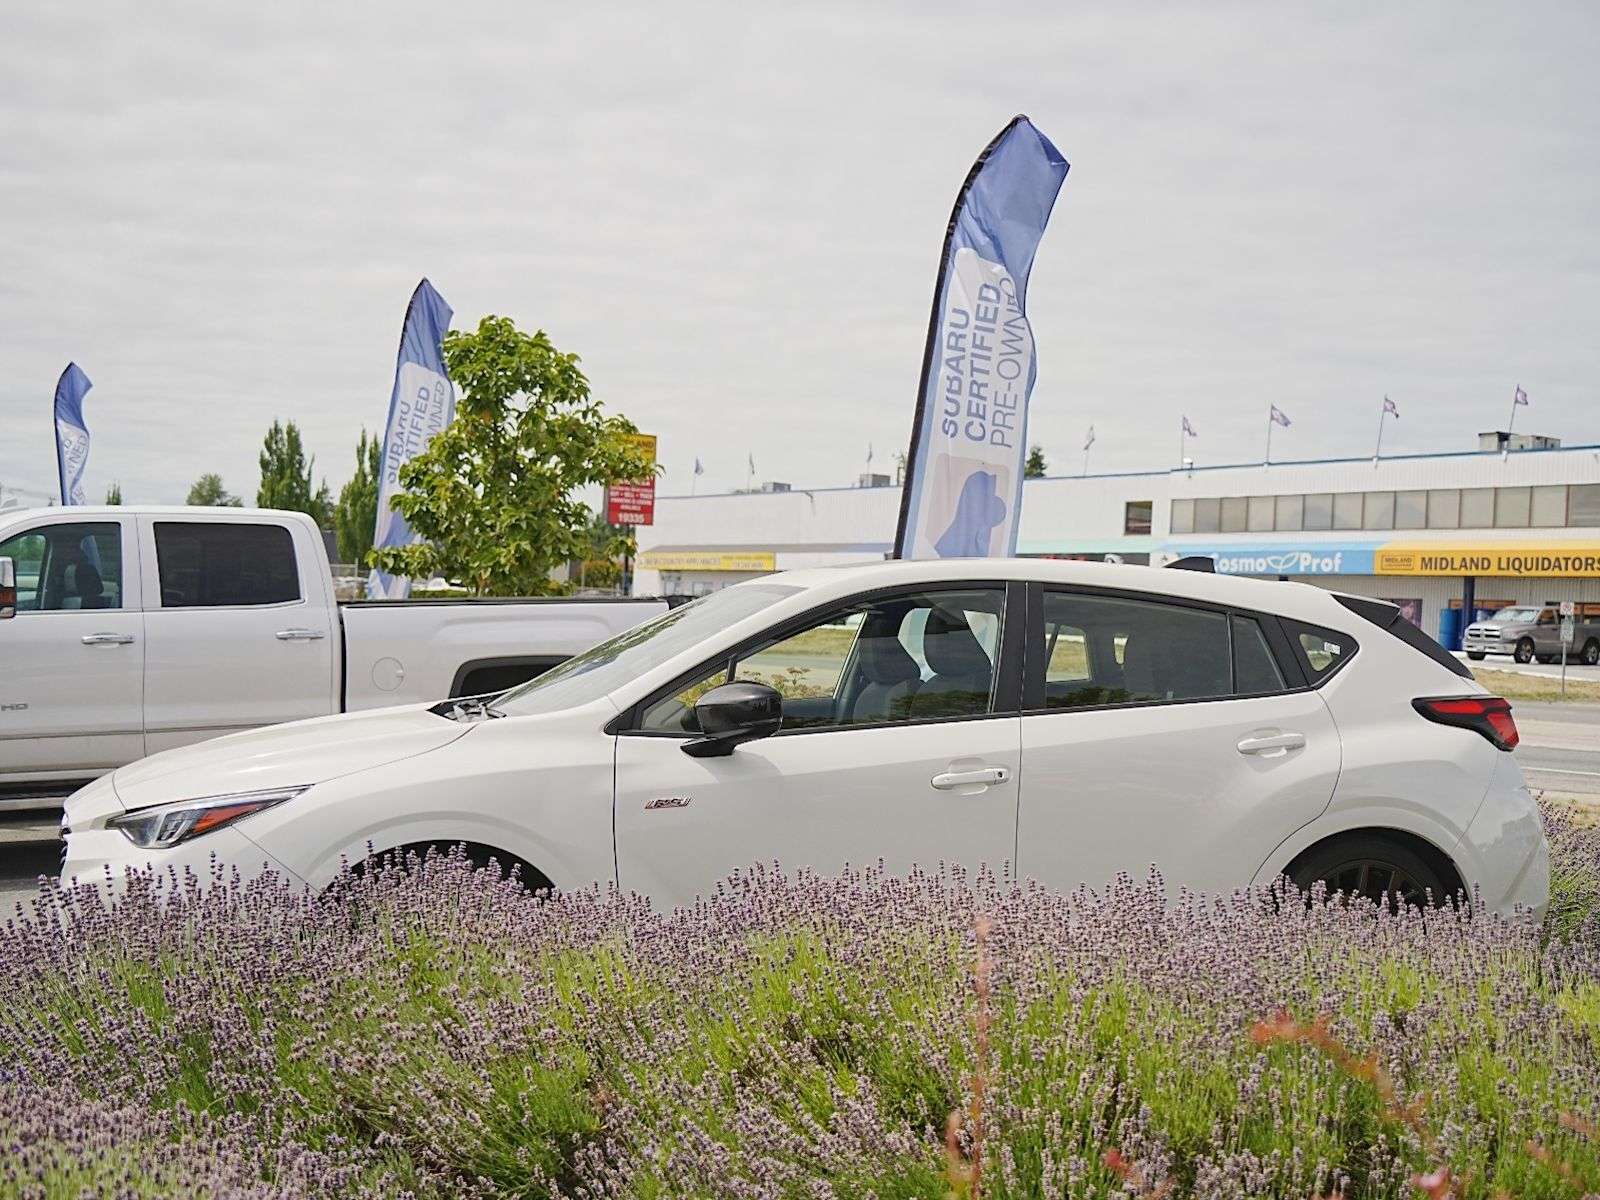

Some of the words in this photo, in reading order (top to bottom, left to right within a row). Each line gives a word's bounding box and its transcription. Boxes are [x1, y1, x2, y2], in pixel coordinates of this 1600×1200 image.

[941, 307, 970, 439] SUBARU
[964, 283, 1001, 442] CERTIFIED
[1299, 551, 1344, 573] Prof
[1420, 556, 1492, 571] MIDLAND
